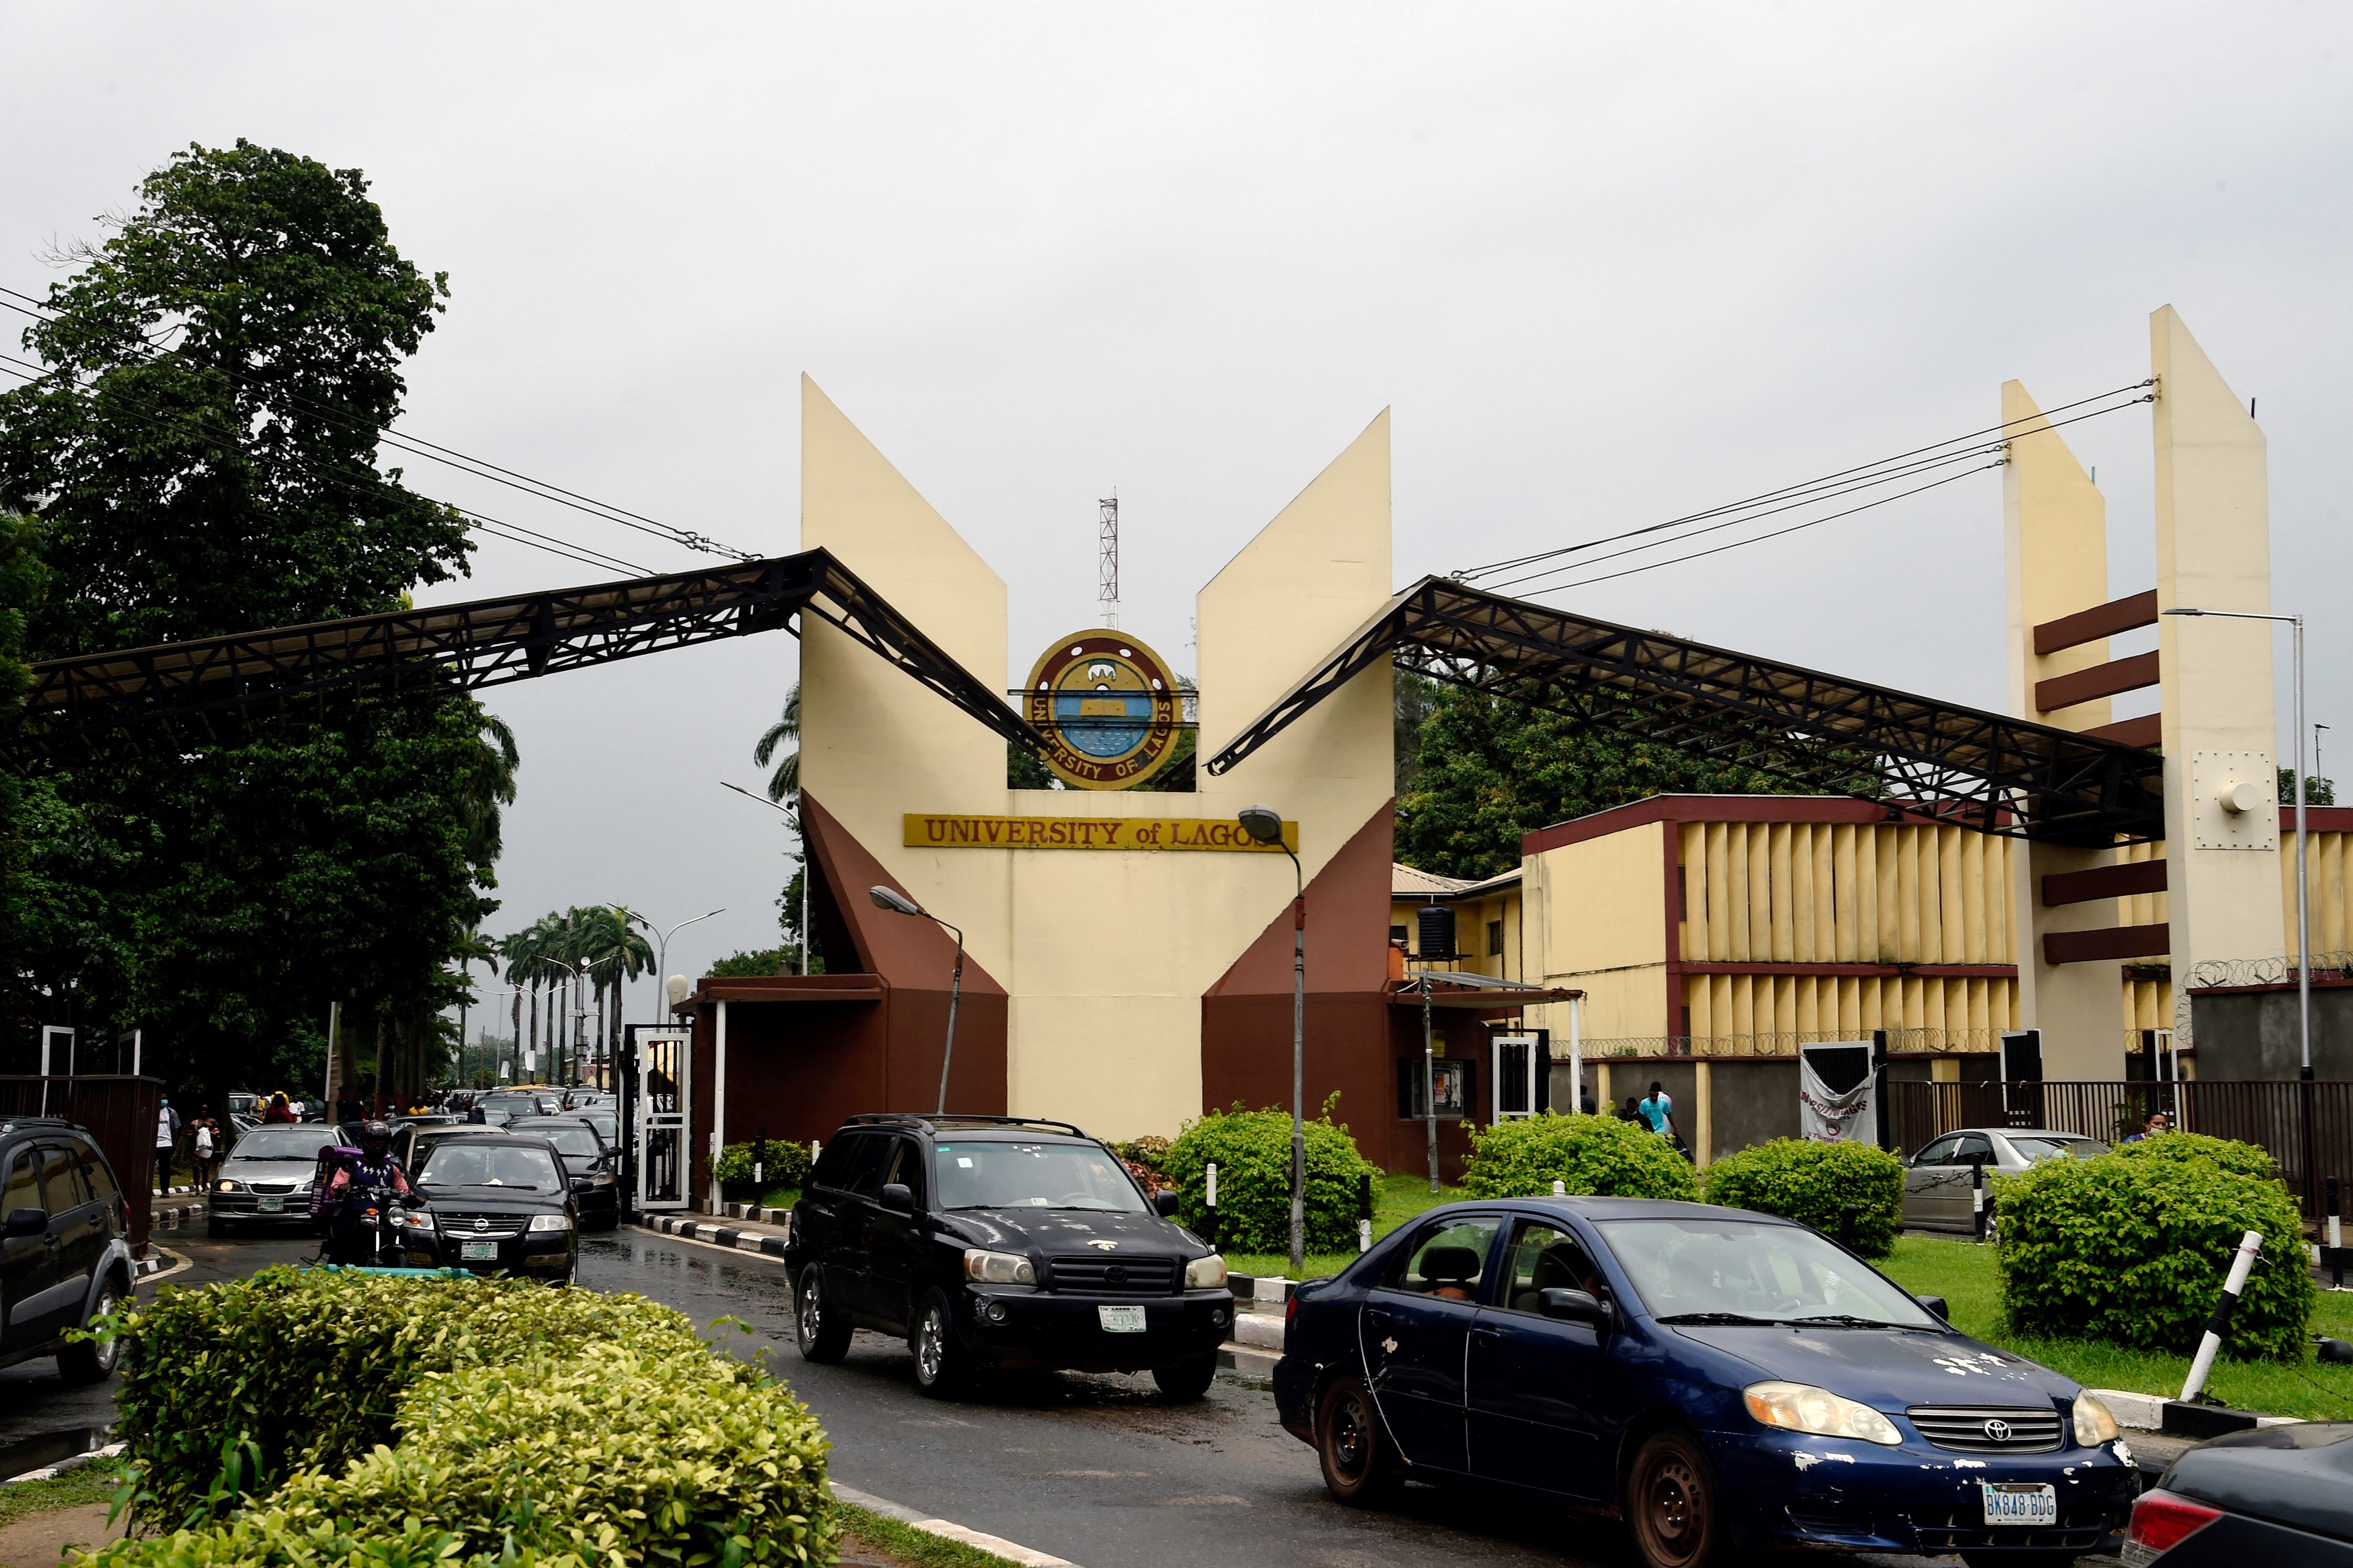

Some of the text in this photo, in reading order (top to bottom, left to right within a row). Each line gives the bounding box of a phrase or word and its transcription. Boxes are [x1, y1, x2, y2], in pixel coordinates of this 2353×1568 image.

[1116, 759, 1136, 777] OF
[1144, 702, 1170, 757] LAGOS
[924, 819, 1122, 845] UNIVERSITY
[1136, 822, 1161, 844] of
